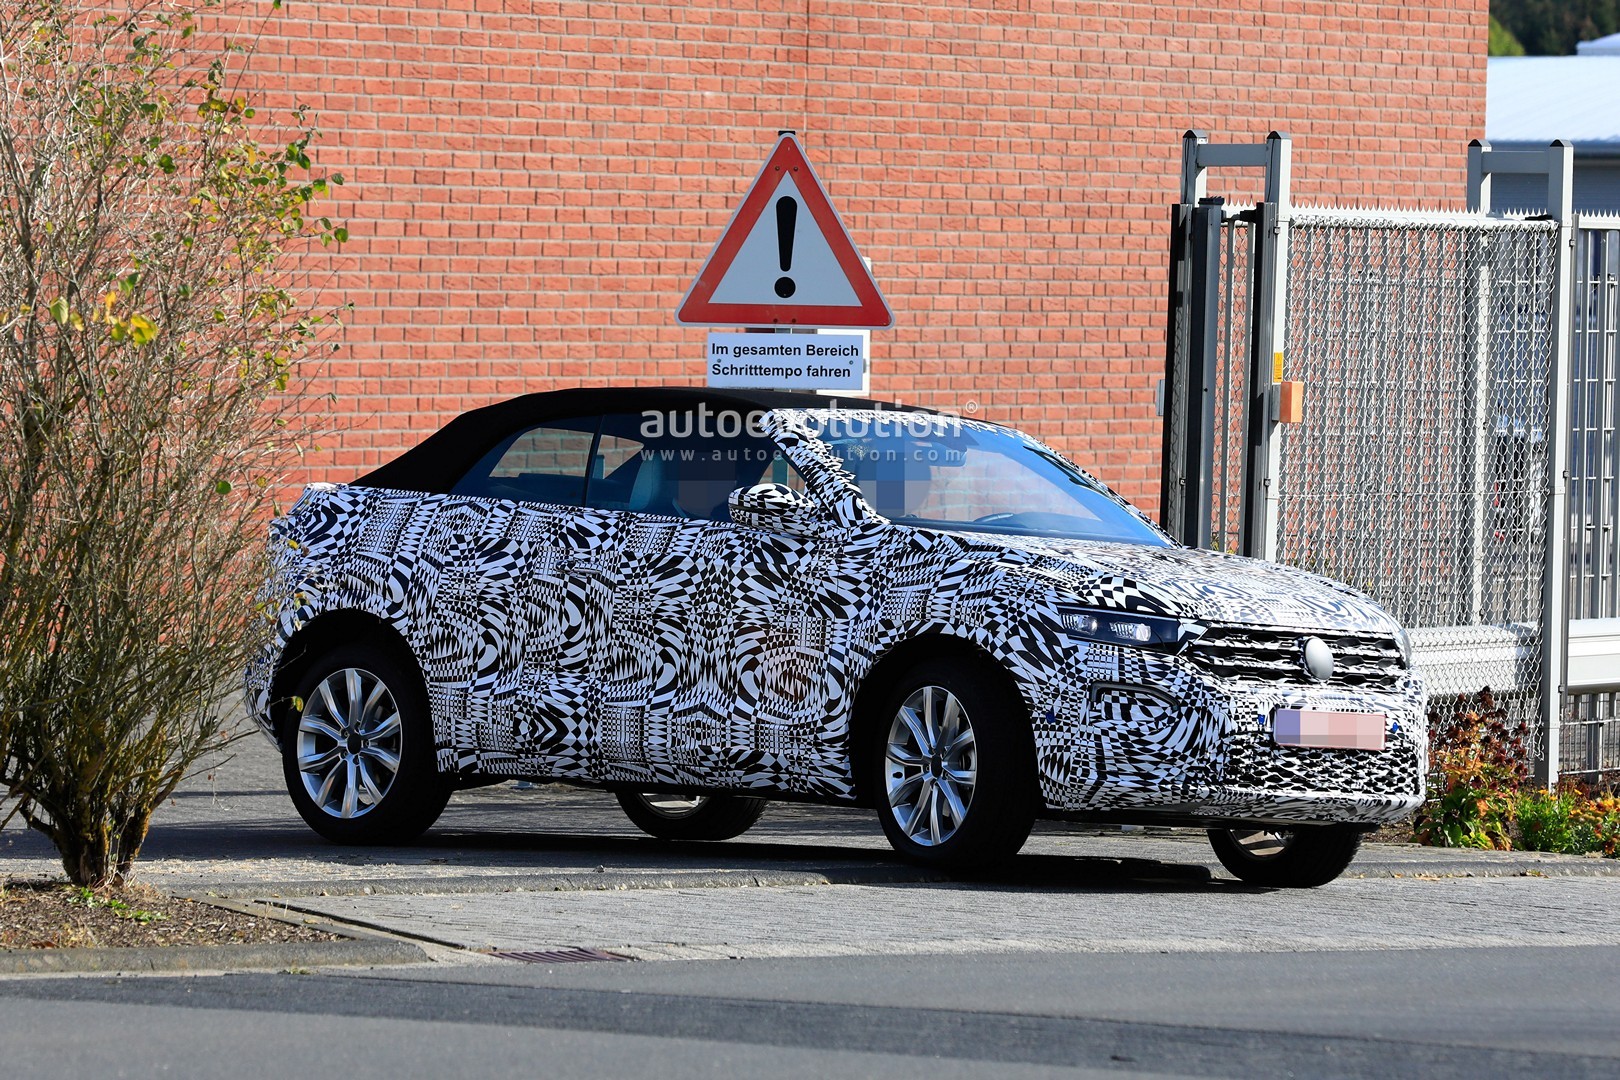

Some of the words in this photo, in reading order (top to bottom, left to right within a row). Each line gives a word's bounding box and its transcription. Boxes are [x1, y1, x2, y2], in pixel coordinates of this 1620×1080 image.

[711, 342, 729, 355] Im
[733, 344, 801, 358] gesamten
[806, 344, 859, 357] Bereich
[711, 363, 803, 379] Schritttempo
[806, 365, 851, 378] fahren
